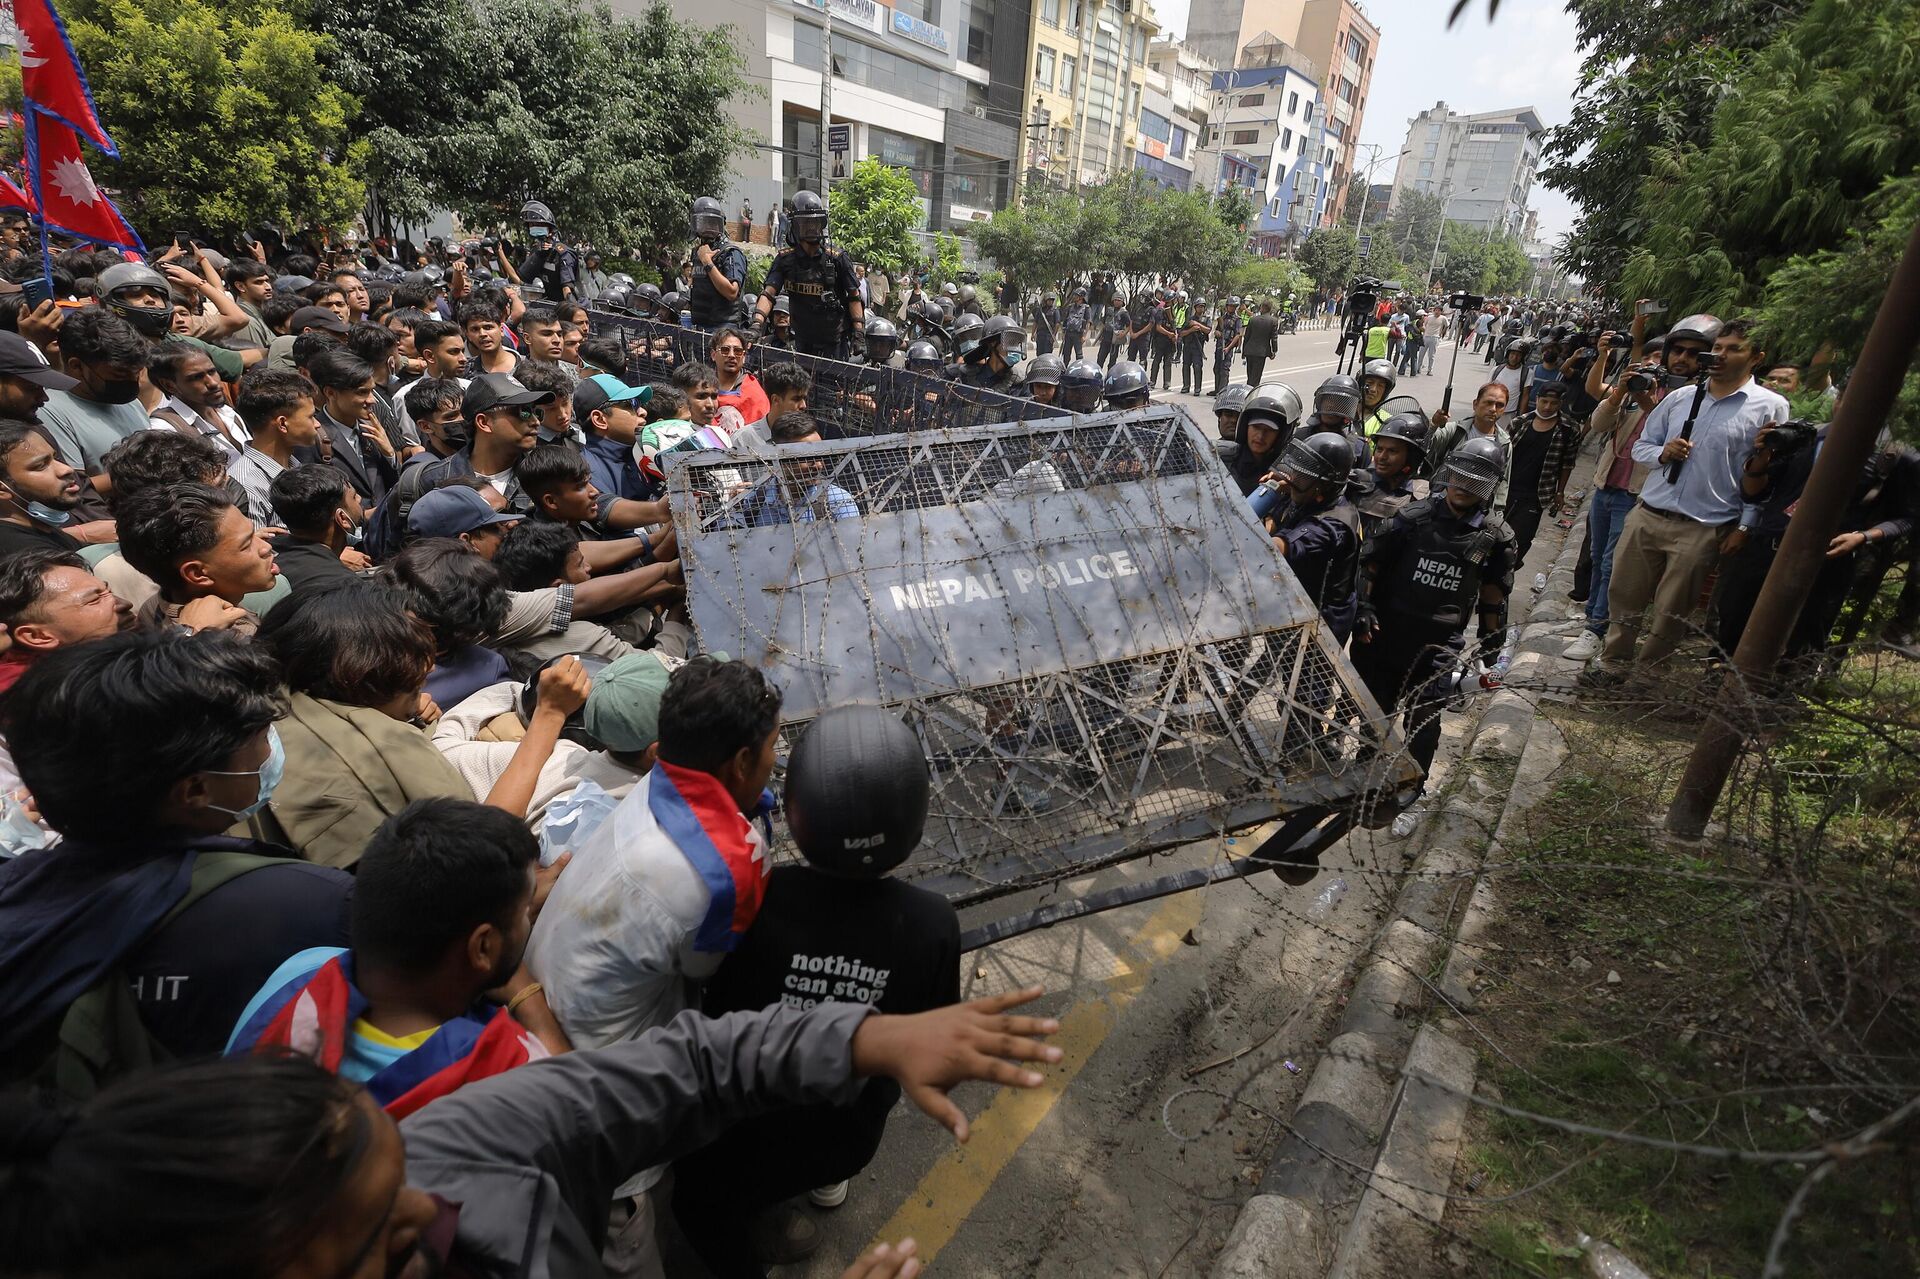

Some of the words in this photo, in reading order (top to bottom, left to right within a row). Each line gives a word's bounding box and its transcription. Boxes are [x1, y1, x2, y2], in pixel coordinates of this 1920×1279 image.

[889, 573, 1009, 611] NEPAL
[1012, 550, 1139, 593] POLICE
[1412, 570, 1460, 591] POLICE
[1417, 557, 1463, 579] NEPAL
[791, 954, 890, 988] nothing
[156, 976, 189, 1000] IT
[785, 974, 828, 994] can
[833, 981, 884, 1006] stop
